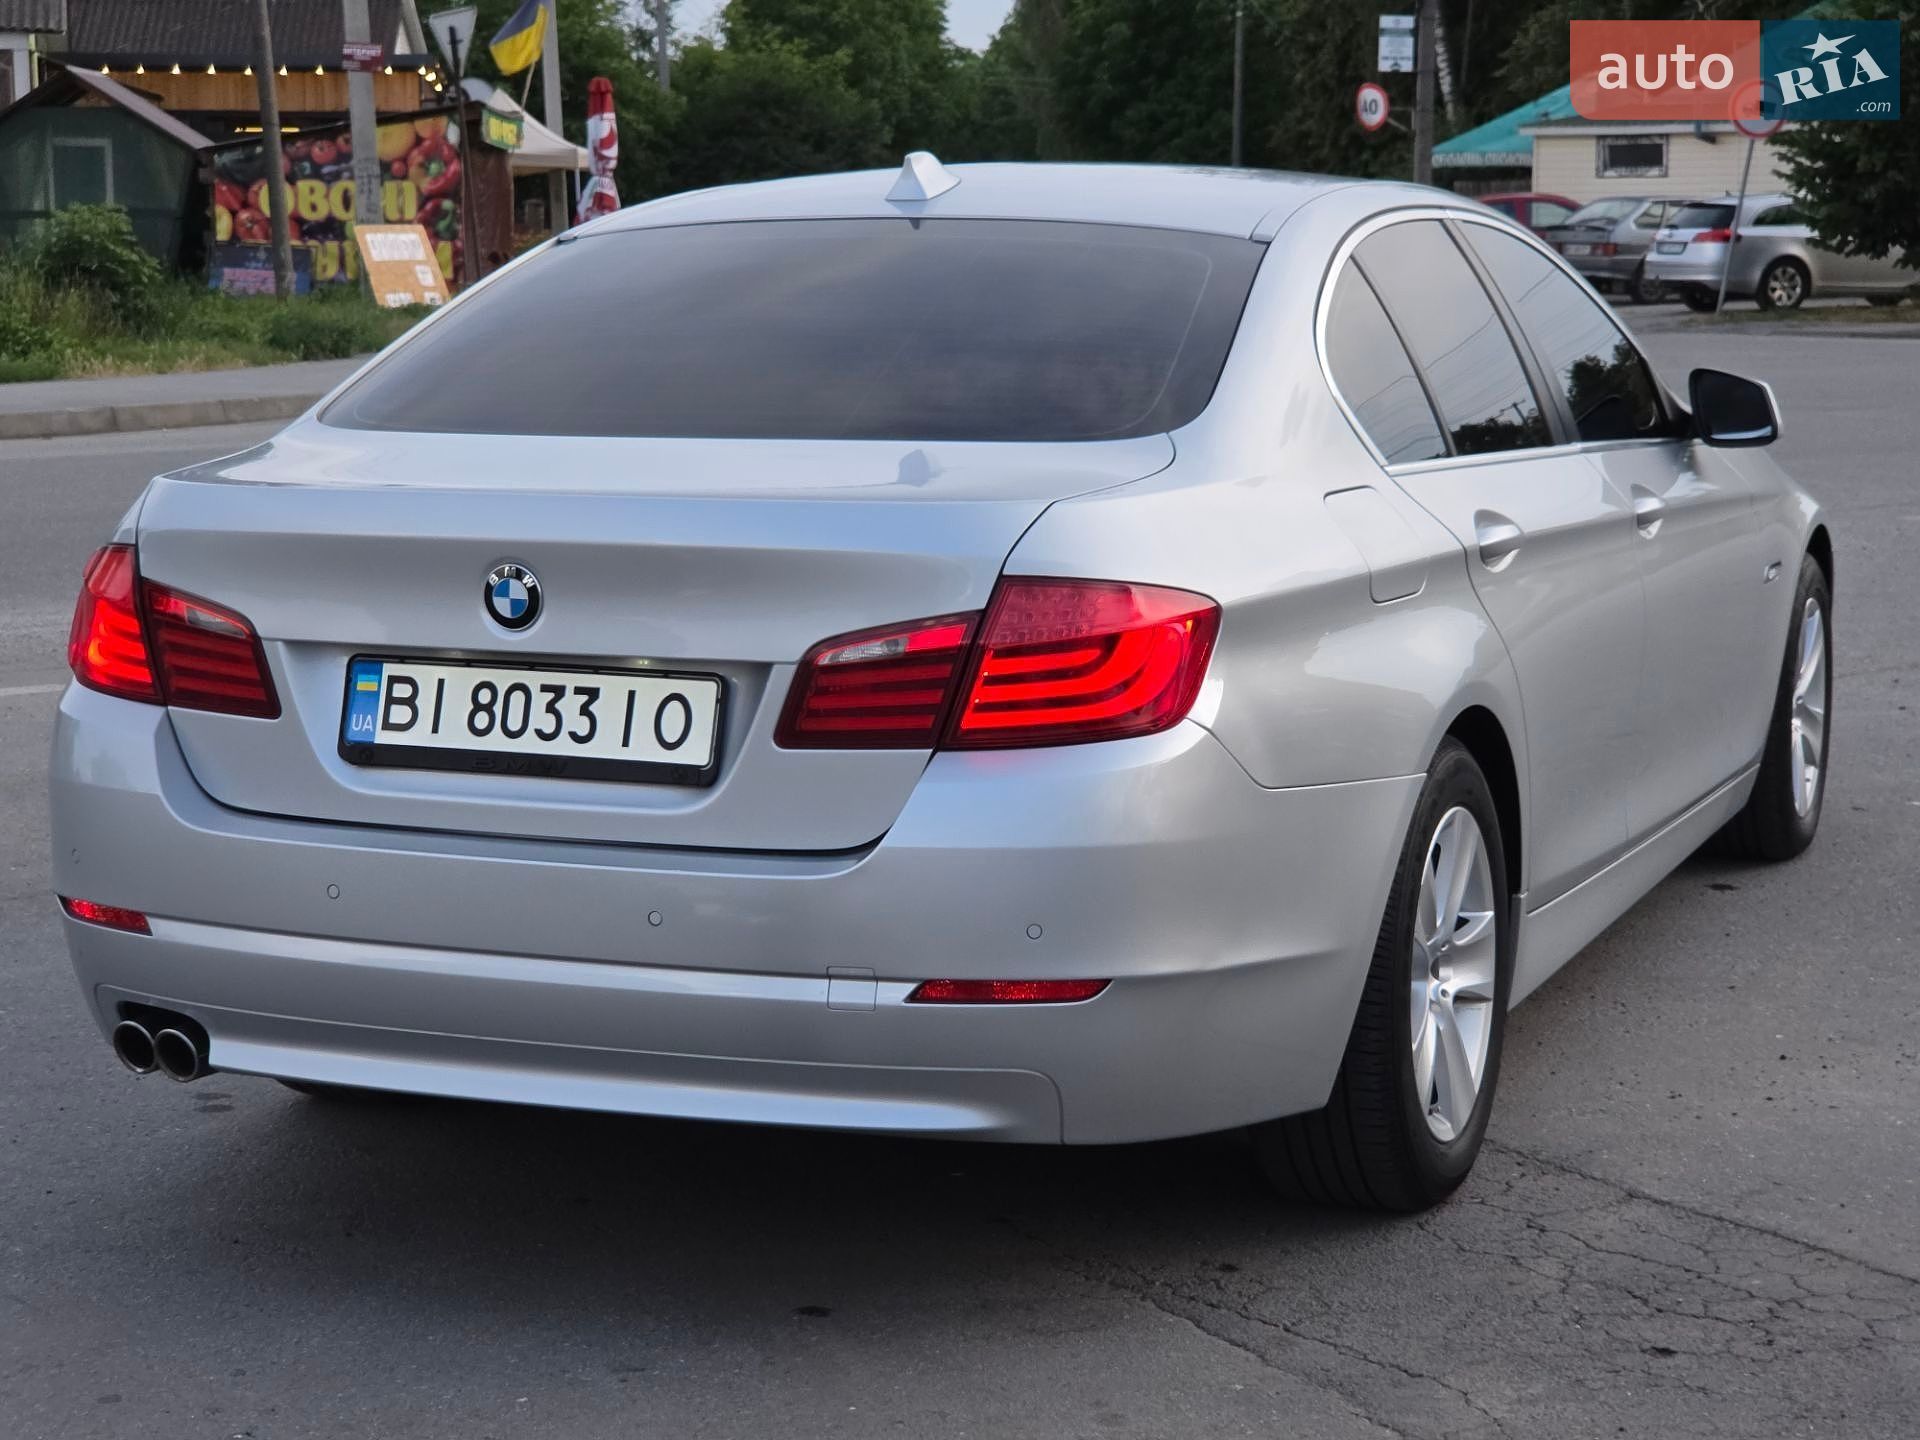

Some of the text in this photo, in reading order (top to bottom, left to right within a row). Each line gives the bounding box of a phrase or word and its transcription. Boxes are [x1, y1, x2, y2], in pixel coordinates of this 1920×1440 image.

[1361, 98, 1379, 115] 40
[488, 566, 536, 588] BMW
[351, 713, 373, 733] UA
[380, 674, 693, 751] BI 8033 IO
